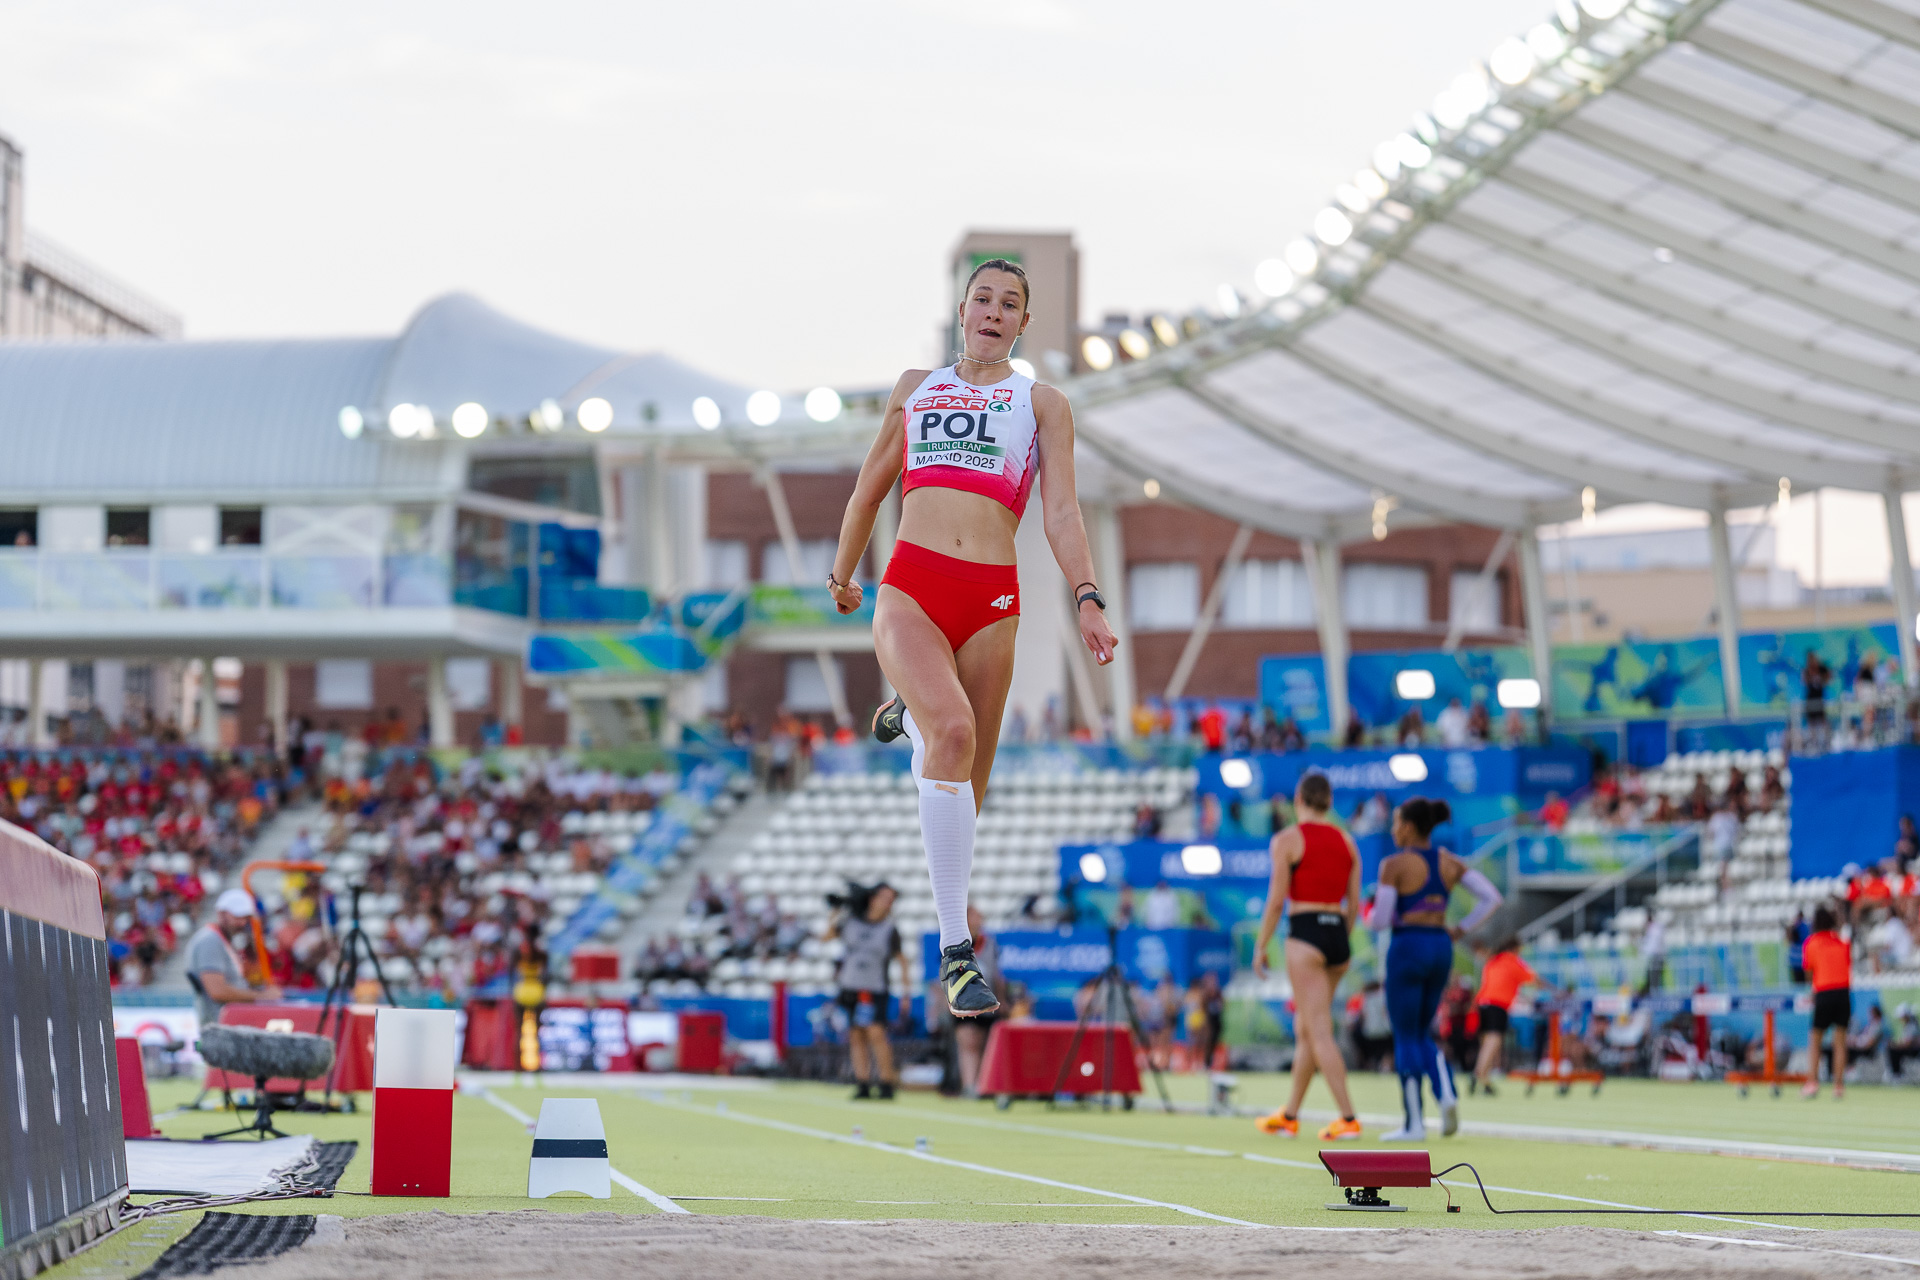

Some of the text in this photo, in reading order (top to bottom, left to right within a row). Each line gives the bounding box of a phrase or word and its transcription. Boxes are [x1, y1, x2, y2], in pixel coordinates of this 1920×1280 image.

[927, 383, 959, 391] 4F
[915, 396, 986, 409] SPAR
[921, 412, 996, 443] POL
[927, 443, 931, 451] I
[932, 442, 951, 450] RUN
[915, 452, 996, 469] MADRID 2025
[990, 594, 1015, 610] 4F
[947, 960, 970, 973] NIKE
